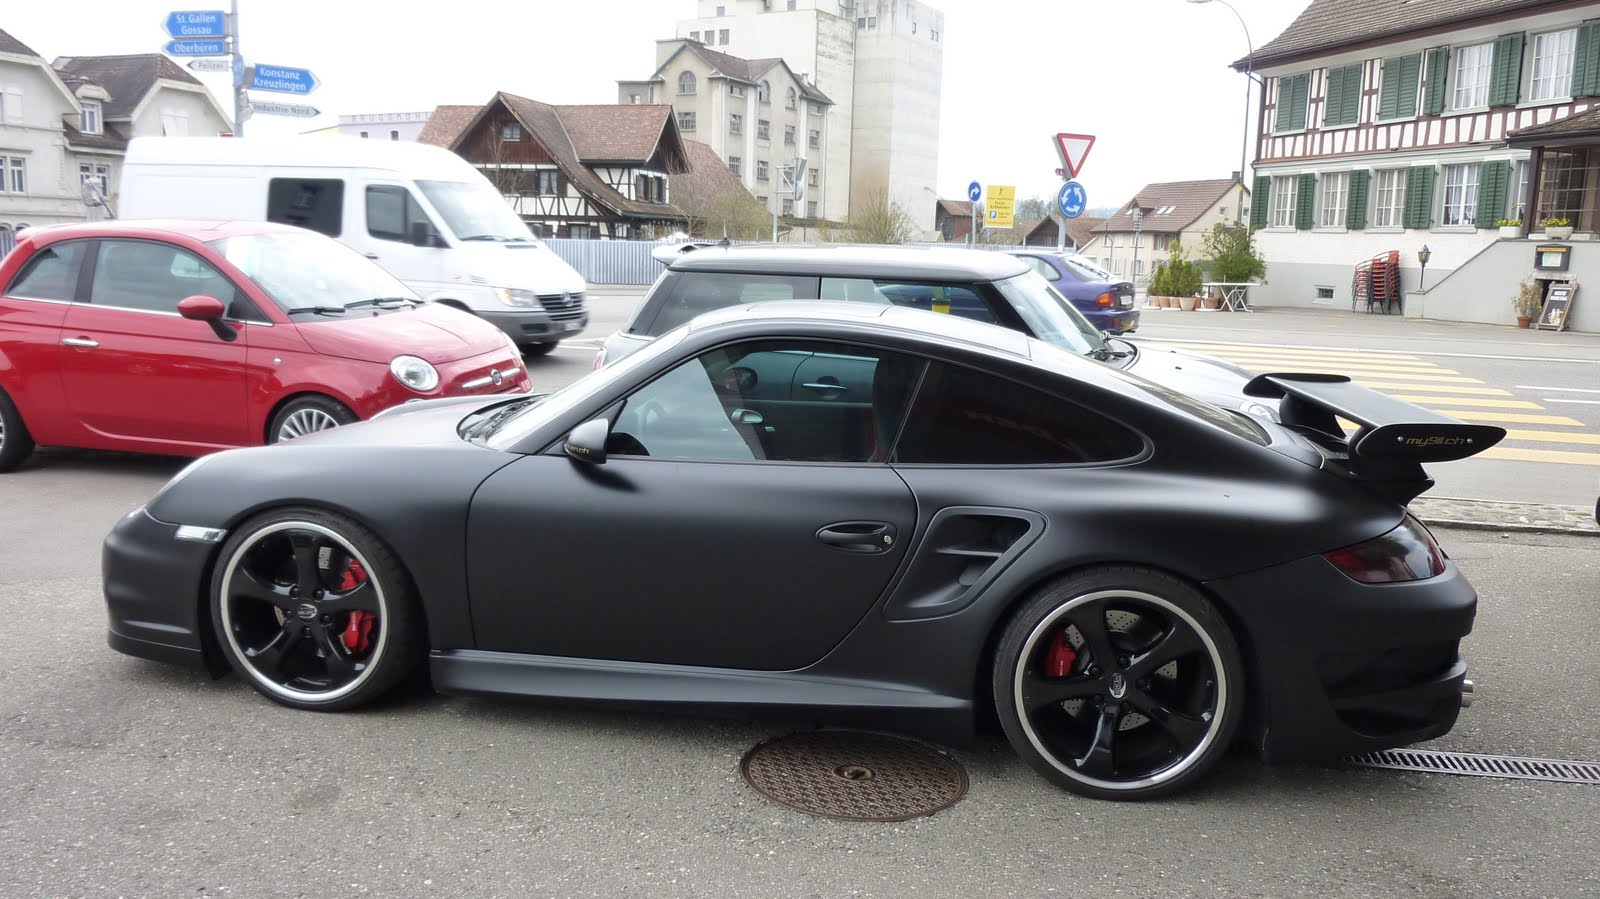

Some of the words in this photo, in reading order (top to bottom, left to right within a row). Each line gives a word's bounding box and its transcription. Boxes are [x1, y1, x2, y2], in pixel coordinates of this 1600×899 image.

[188, 13, 216, 24] Gallen
[181, 25, 212, 35] Gossau
[174, 42, 219, 53] Oberbüren
[198, 61, 224, 70] Polizei
[260, 67, 299, 80] Konstanz
[254, 77, 306, 92] Kreuzlingen
[253, 103, 289, 114] Industrie
[291, 106, 310, 115] Nord
